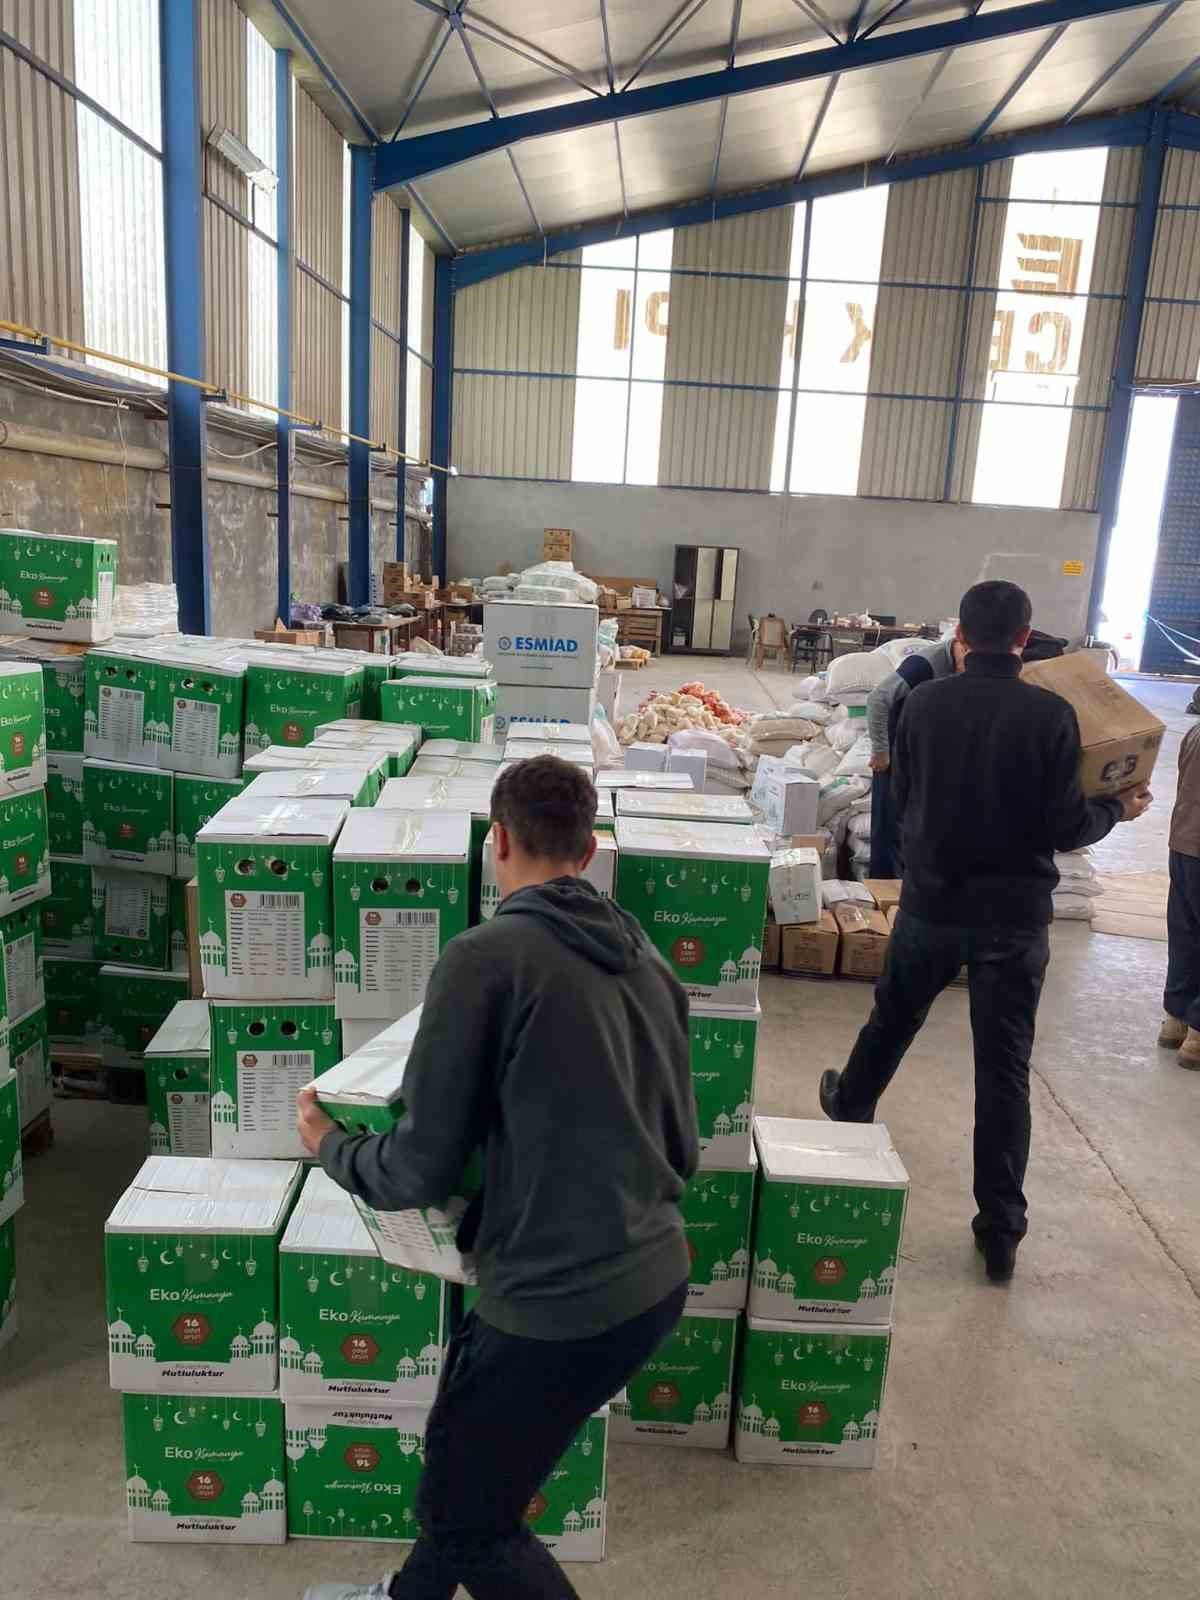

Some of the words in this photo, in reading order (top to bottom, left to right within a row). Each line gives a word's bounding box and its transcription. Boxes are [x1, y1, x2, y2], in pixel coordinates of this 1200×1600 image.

[515, 636, 578, 652] ESMİAD
[654, 911, 680, 923] Eko
[681, 941, 695, 950] 16
[797, 1233, 822, 1245] Eko
[823, 1260, 836, 1269] 16
[150, 1289, 180, 1301] Eko
[319, 1309, 348, 1321] Eko
[184, 1319, 199, 1327] 16
[352, 1339, 366, 1347] 16
[781, 1379, 806, 1391] Eko
[807, 1406, 819, 1414] 16
[164, 1447, 192, 1459] Eko
[356, 1459, 370, 1467] 16
[374, 1482, 401, 1495] Eko
